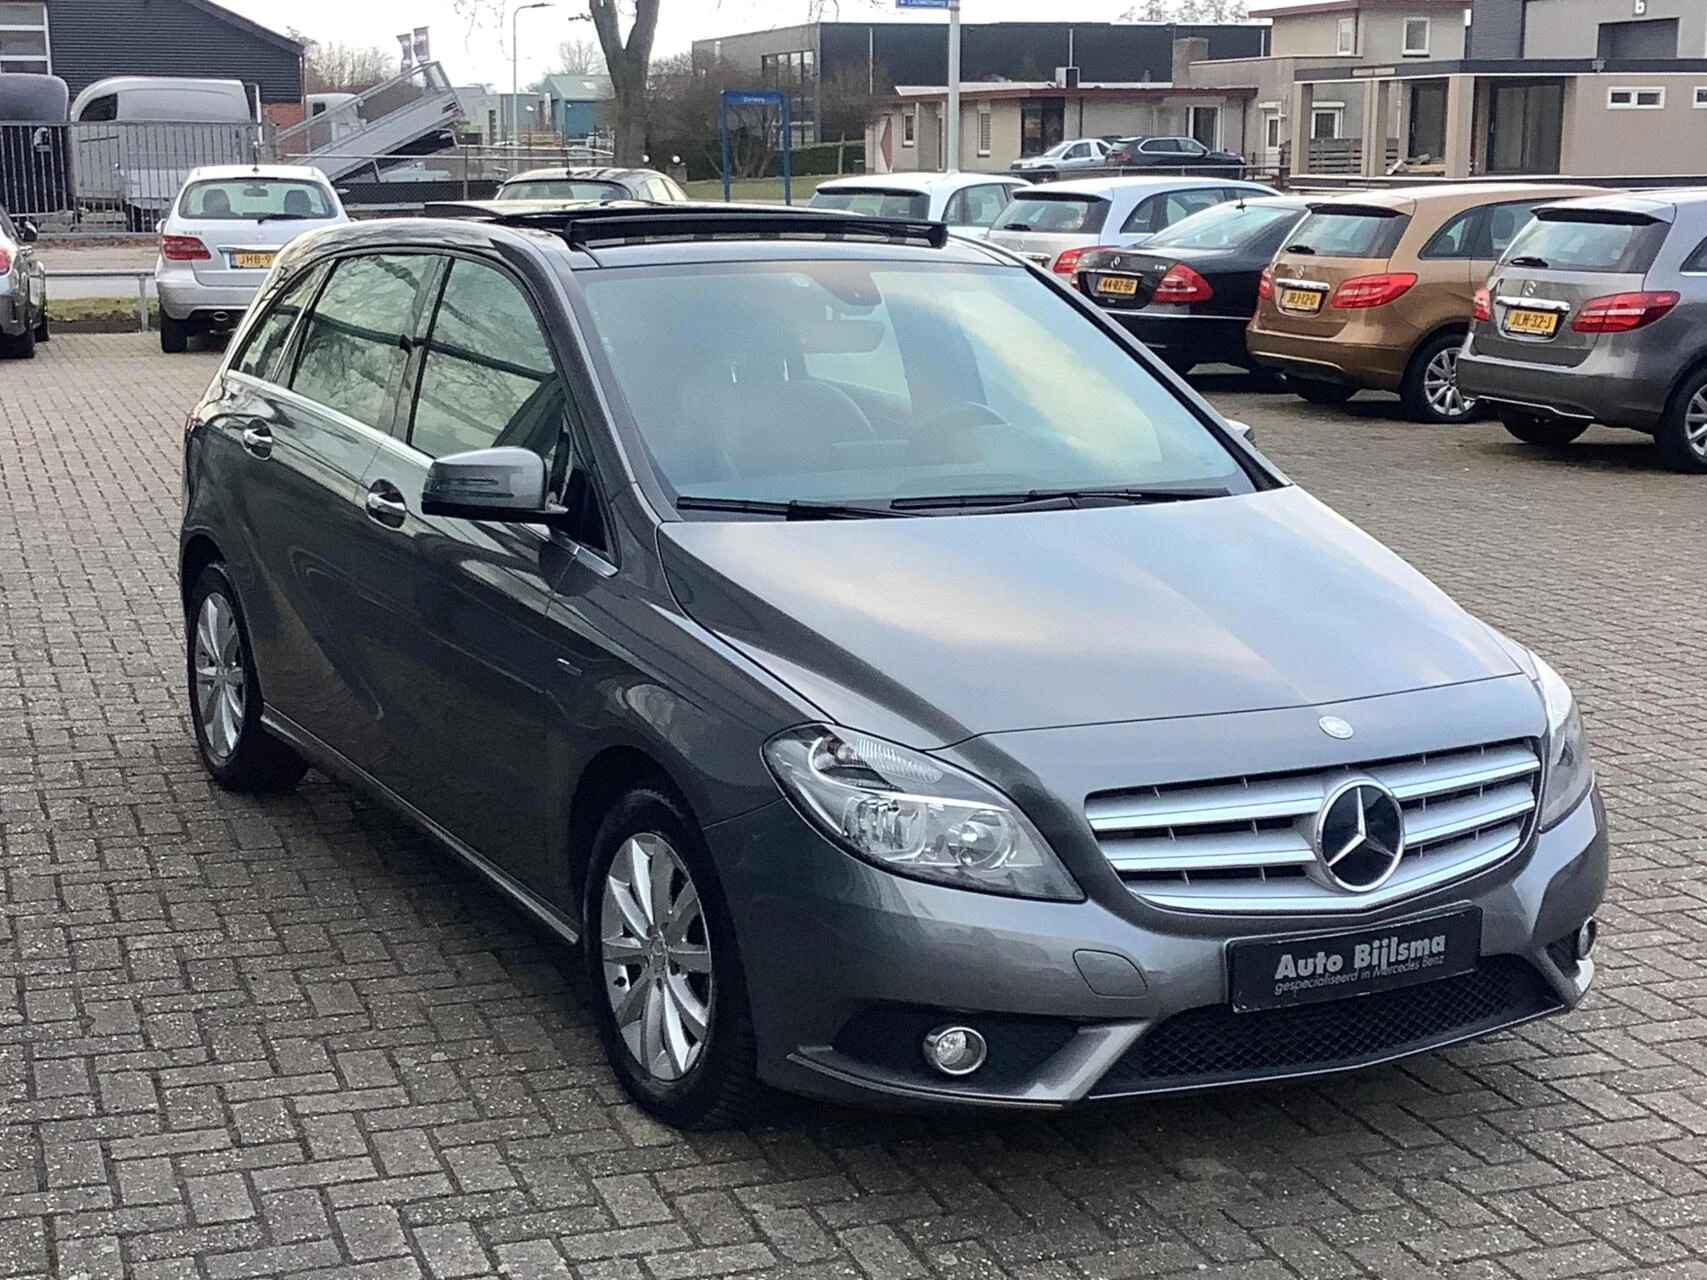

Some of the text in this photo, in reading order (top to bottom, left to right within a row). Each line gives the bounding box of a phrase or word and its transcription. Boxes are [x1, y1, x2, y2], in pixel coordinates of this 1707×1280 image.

[1274, 935, 1446, 980] Auto Bijlsma
[1274, 968, 1360, 998] gespecialiseerd
[1361, 969, 1371, 981] in
